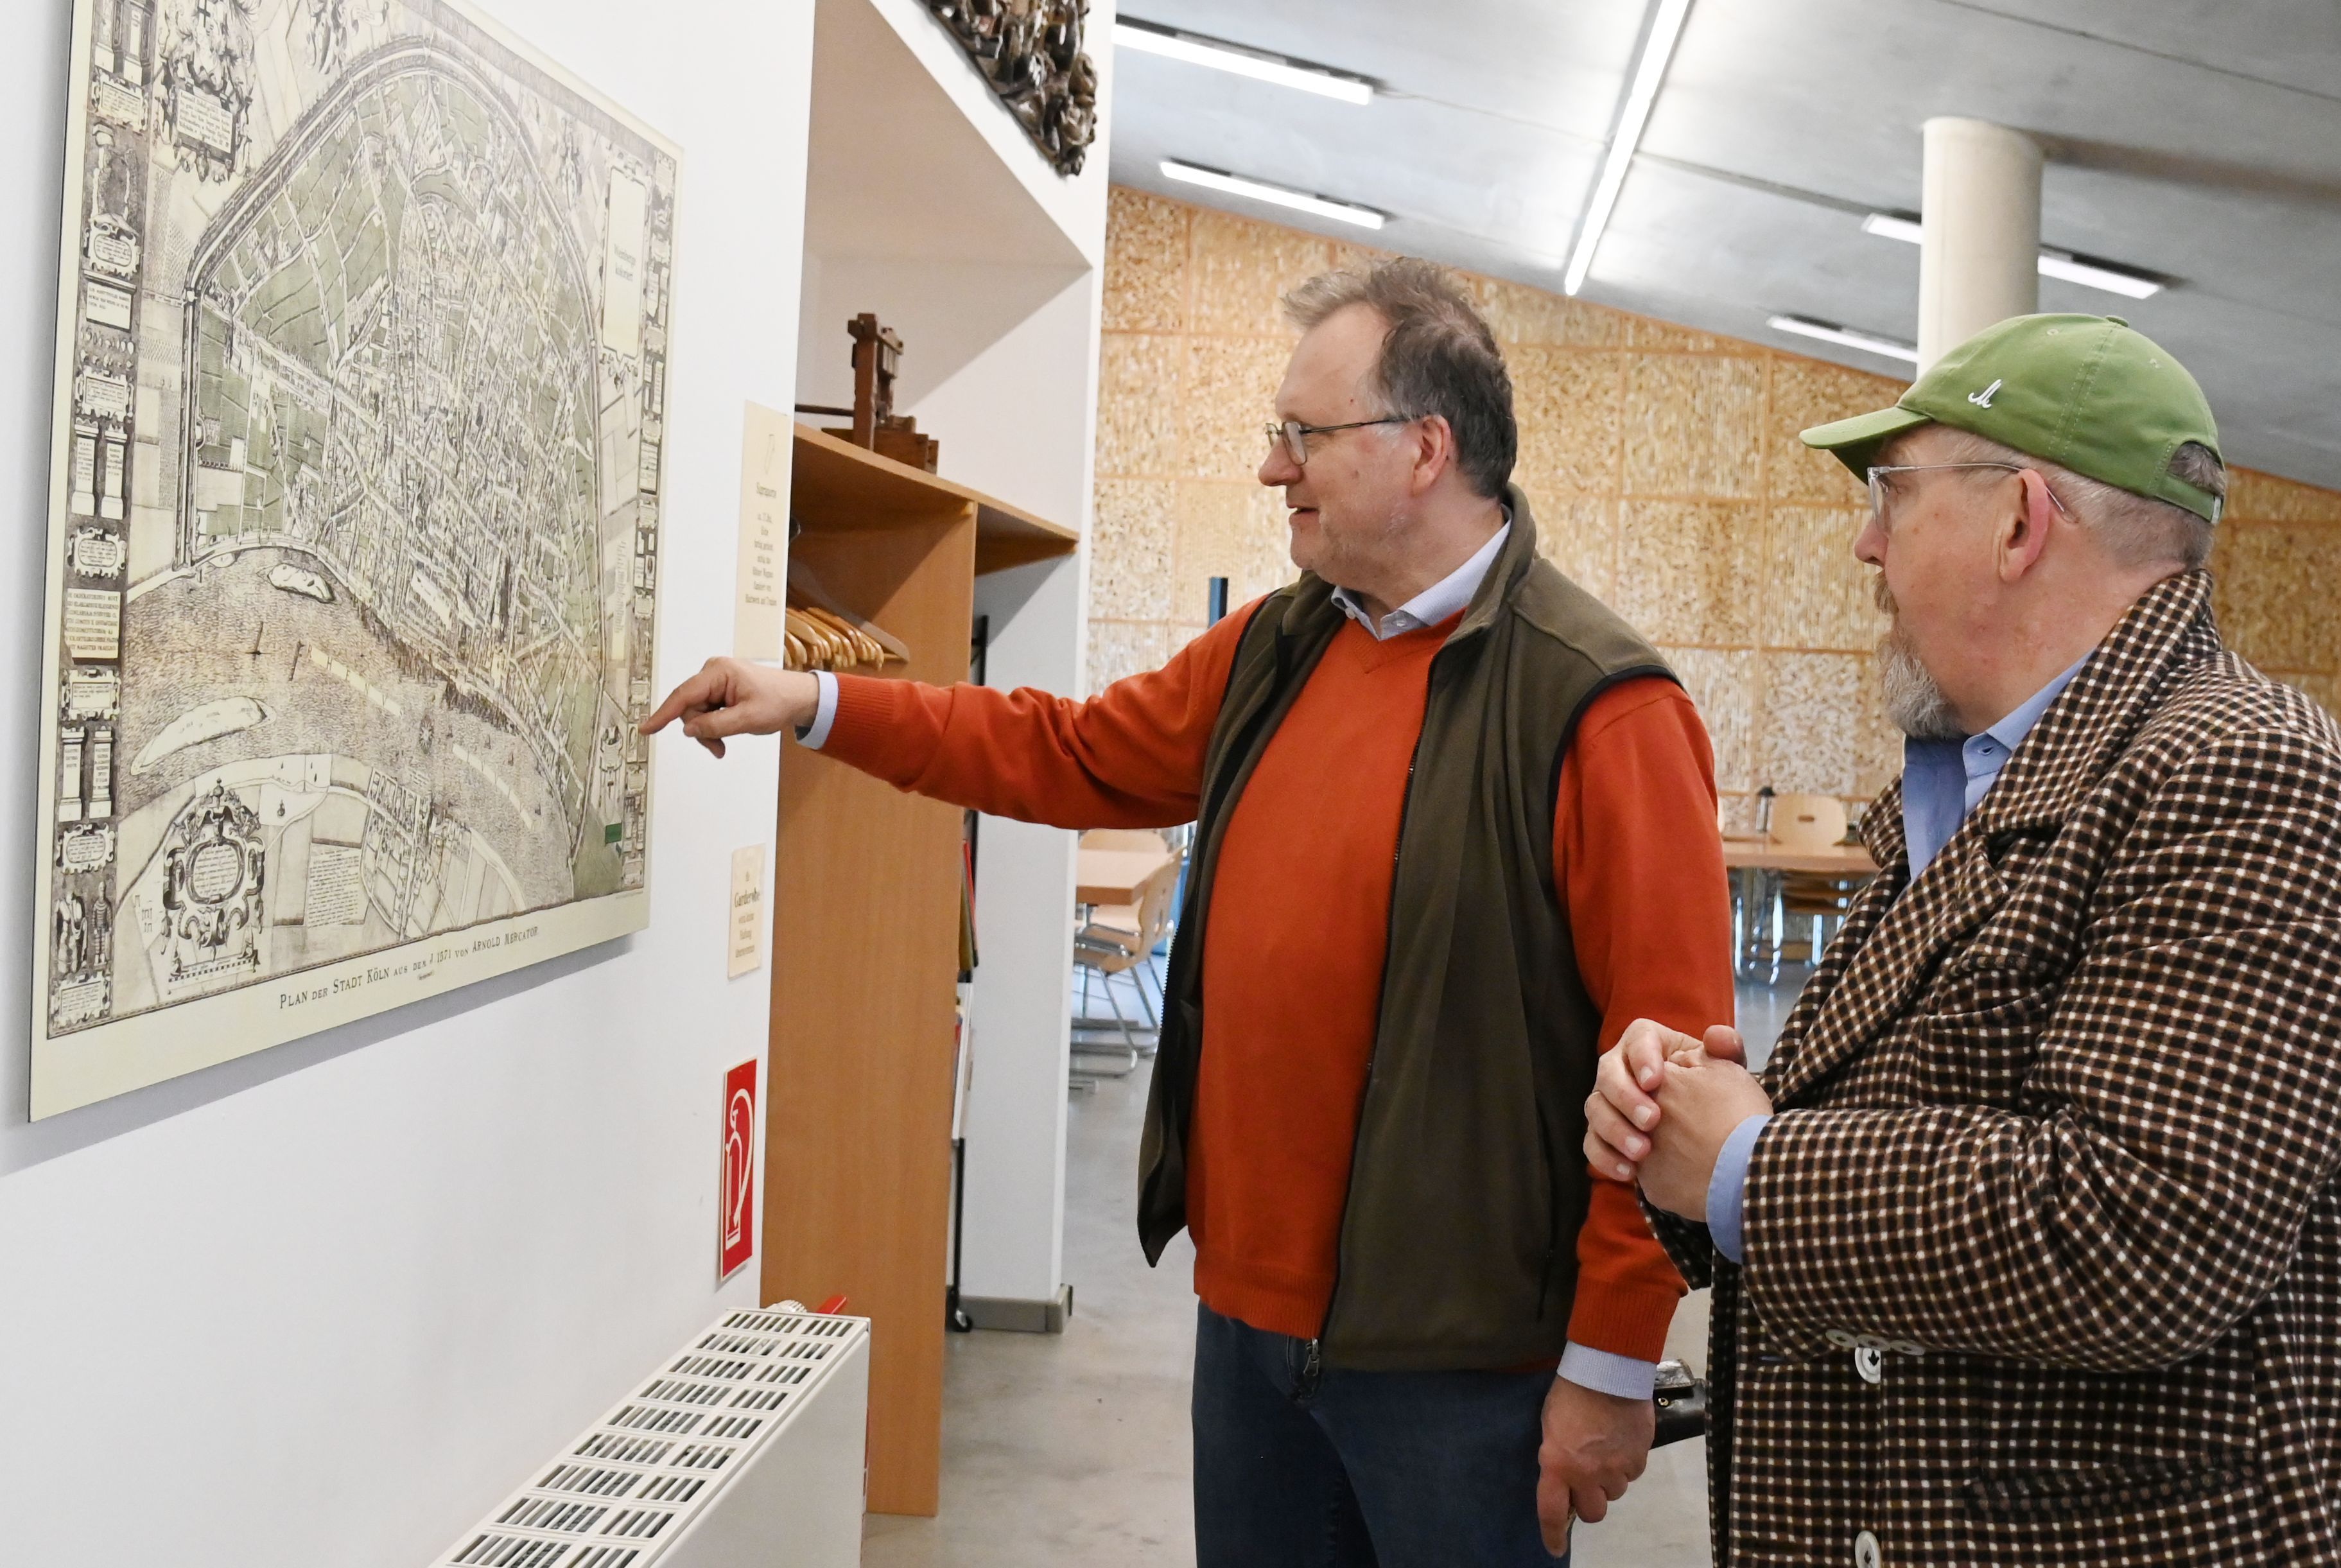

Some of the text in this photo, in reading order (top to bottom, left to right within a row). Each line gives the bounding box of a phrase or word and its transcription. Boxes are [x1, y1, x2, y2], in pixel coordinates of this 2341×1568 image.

[279, 990, 309, 1009] PLAN
[311, 988, 329, 1001] DER
[333, 975, 363, 994] STADT
[367, 966, 390, 984] KÖLN
[393, 965, 408, 977] AUS
[437, 949, 452, 964] 1571
[454, 948, 469, 959] VON
[472, 936, 501, 953] ARNOLD
[504, 926, 539, 946] MERCATOR
